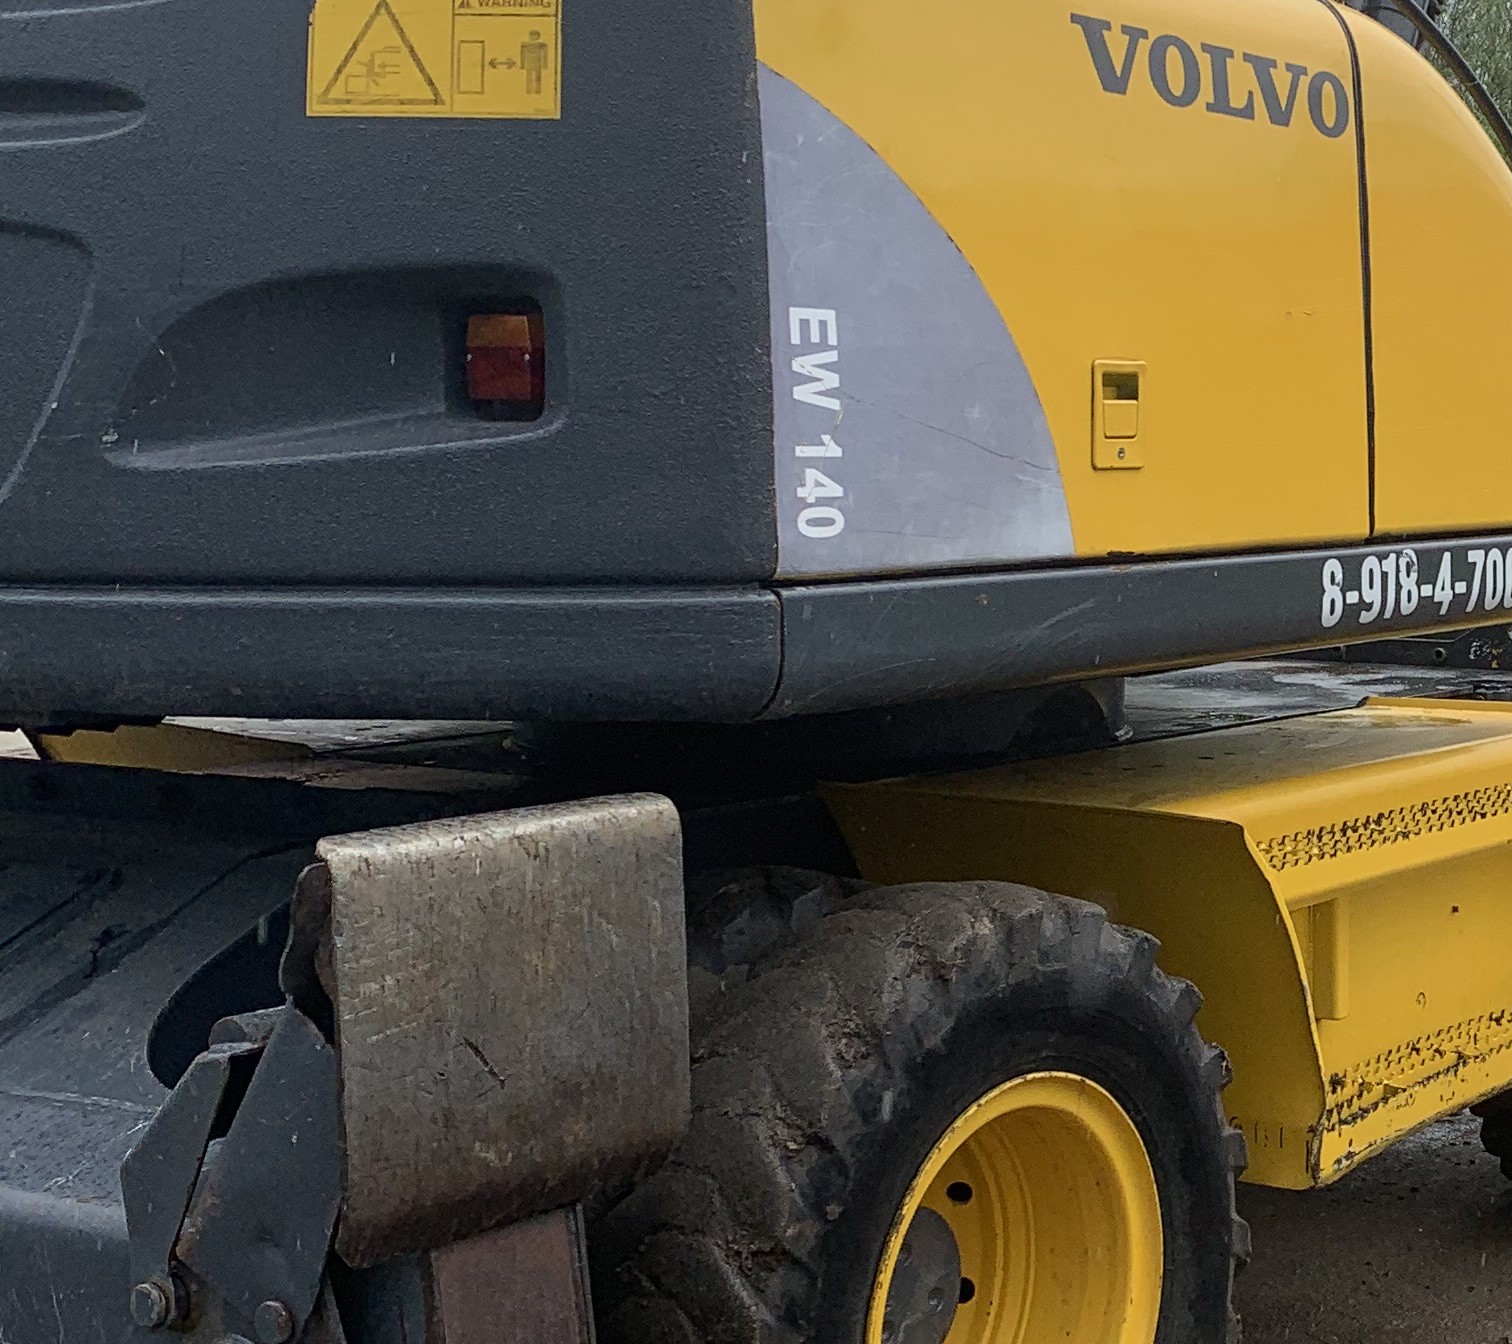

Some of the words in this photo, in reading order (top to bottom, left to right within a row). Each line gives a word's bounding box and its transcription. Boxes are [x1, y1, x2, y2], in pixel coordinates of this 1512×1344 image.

[1070, 12, 1349, 138] VOLVO
[789, 307, 841, 410] EW
[795, 434, 845, 538] 140
